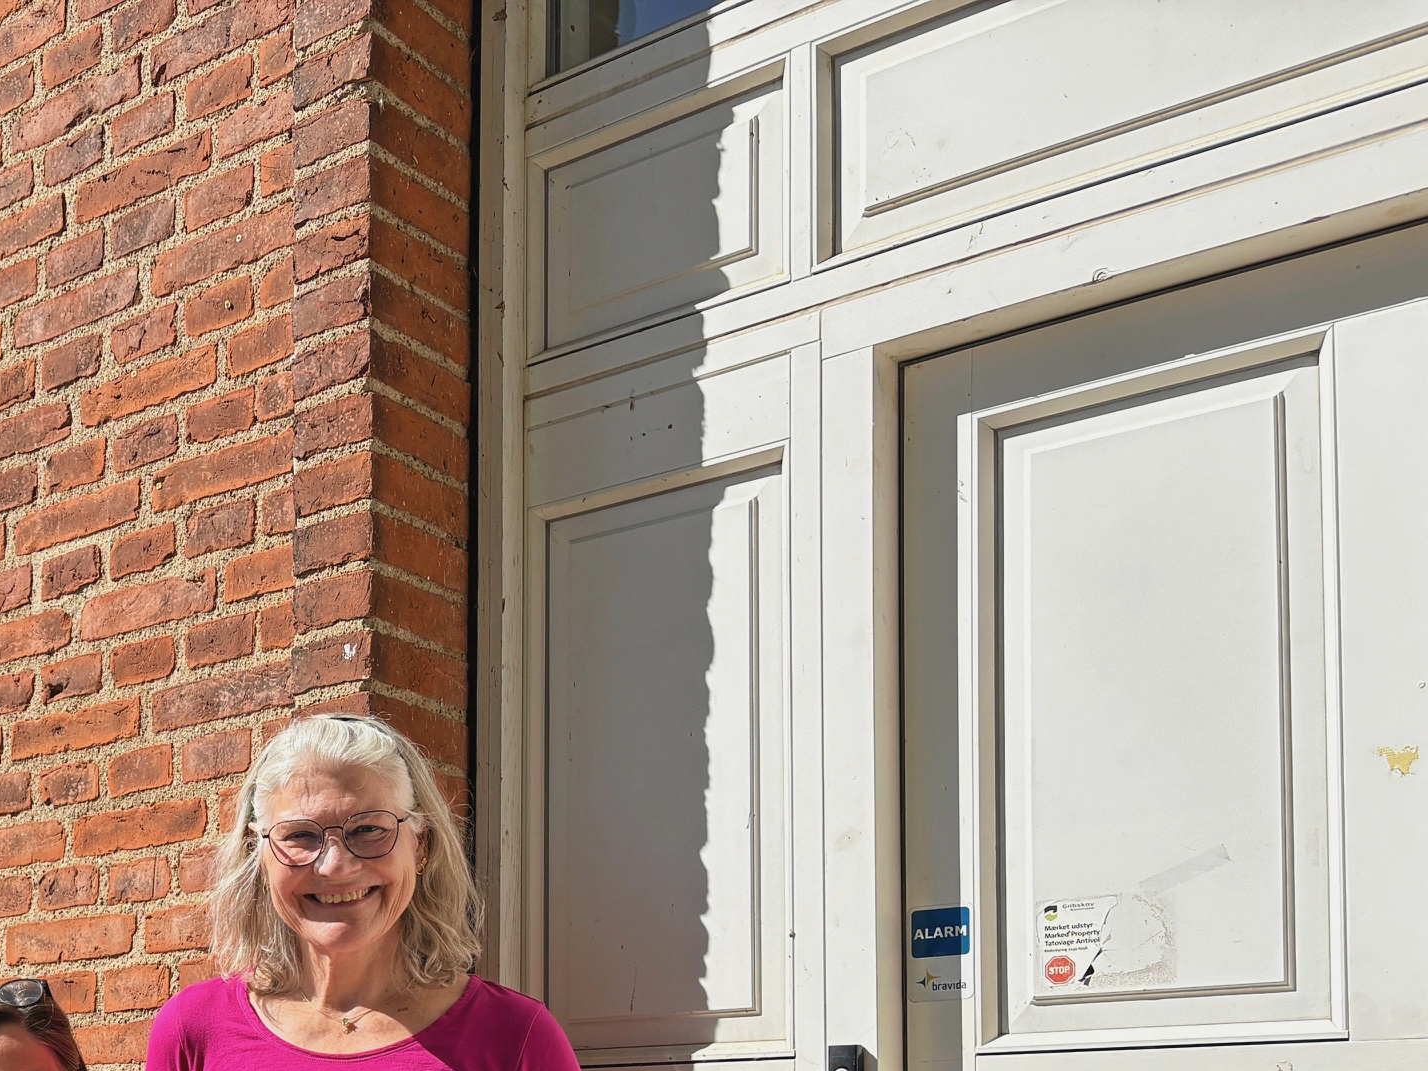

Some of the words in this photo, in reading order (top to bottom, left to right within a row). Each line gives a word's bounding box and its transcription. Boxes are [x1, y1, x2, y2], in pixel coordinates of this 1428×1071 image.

[913, 924, 967, 941] ALARM
[1044, 931, 1070, 939] Marked
[1071, 929, 1100, 937] Property
[1044, 939, 1075, 947] Tatovage
[1048, 965, 1071, 975] STOP
[932, 980, 967, 991] bravida
